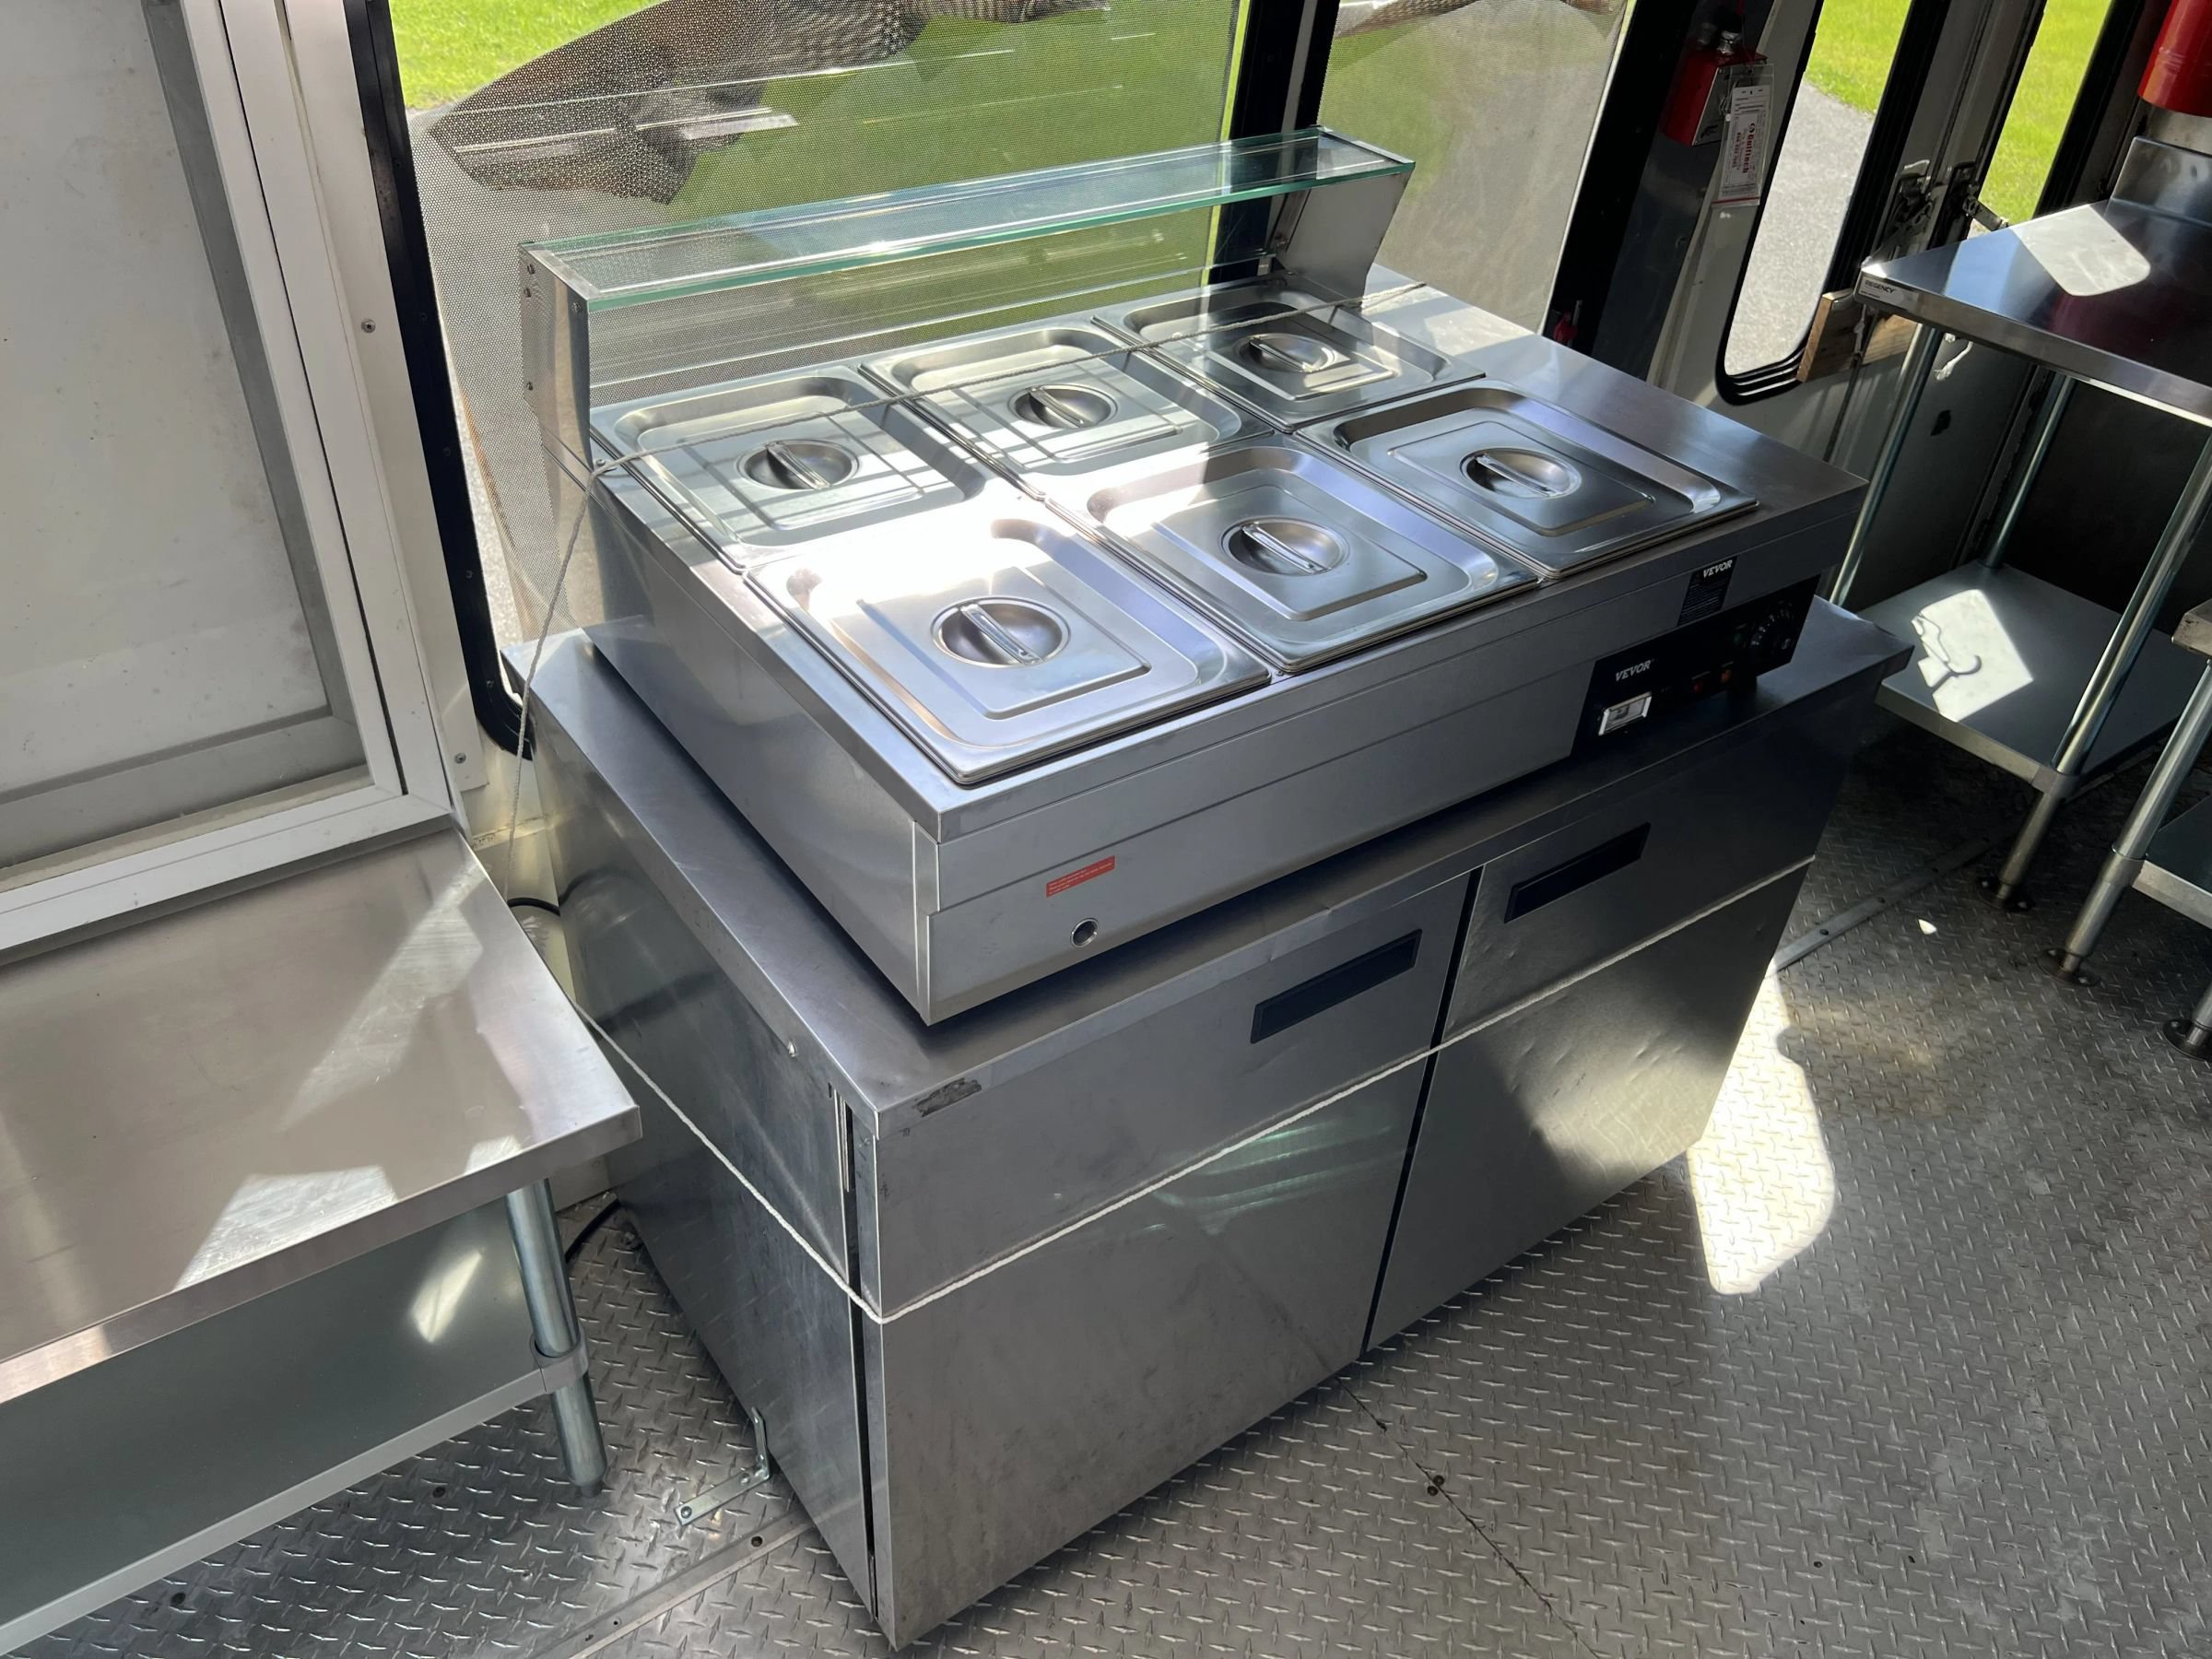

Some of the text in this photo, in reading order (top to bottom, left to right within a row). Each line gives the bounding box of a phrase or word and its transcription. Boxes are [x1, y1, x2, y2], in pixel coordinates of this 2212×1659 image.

[1865, 279, 1896, 294] REGENCY
[1703, 559, 1733, 579] VEVOR
[1615, 659, 1652, 682] VEVOR
